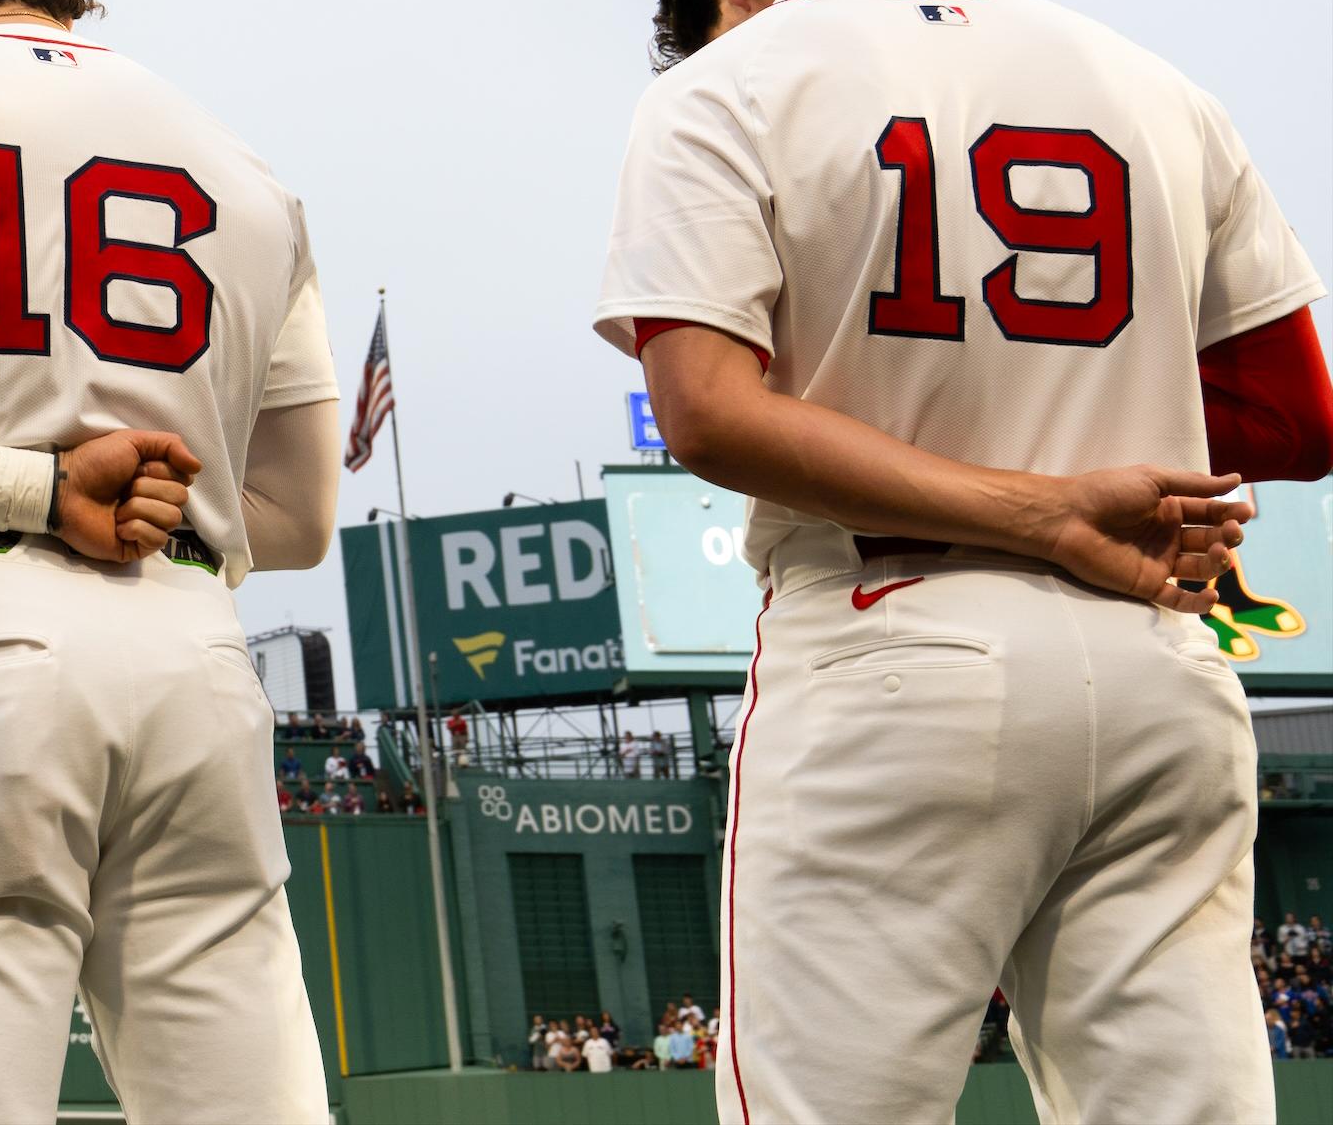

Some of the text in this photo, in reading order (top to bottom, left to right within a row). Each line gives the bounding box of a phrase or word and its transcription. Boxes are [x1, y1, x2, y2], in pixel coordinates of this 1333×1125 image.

[868, 116, 1133, 347] 19
[441, 519, 611, 610] RED
[513, 638, 624, 676] Fanat
[515, 804, 692, 834] ABIOMED
